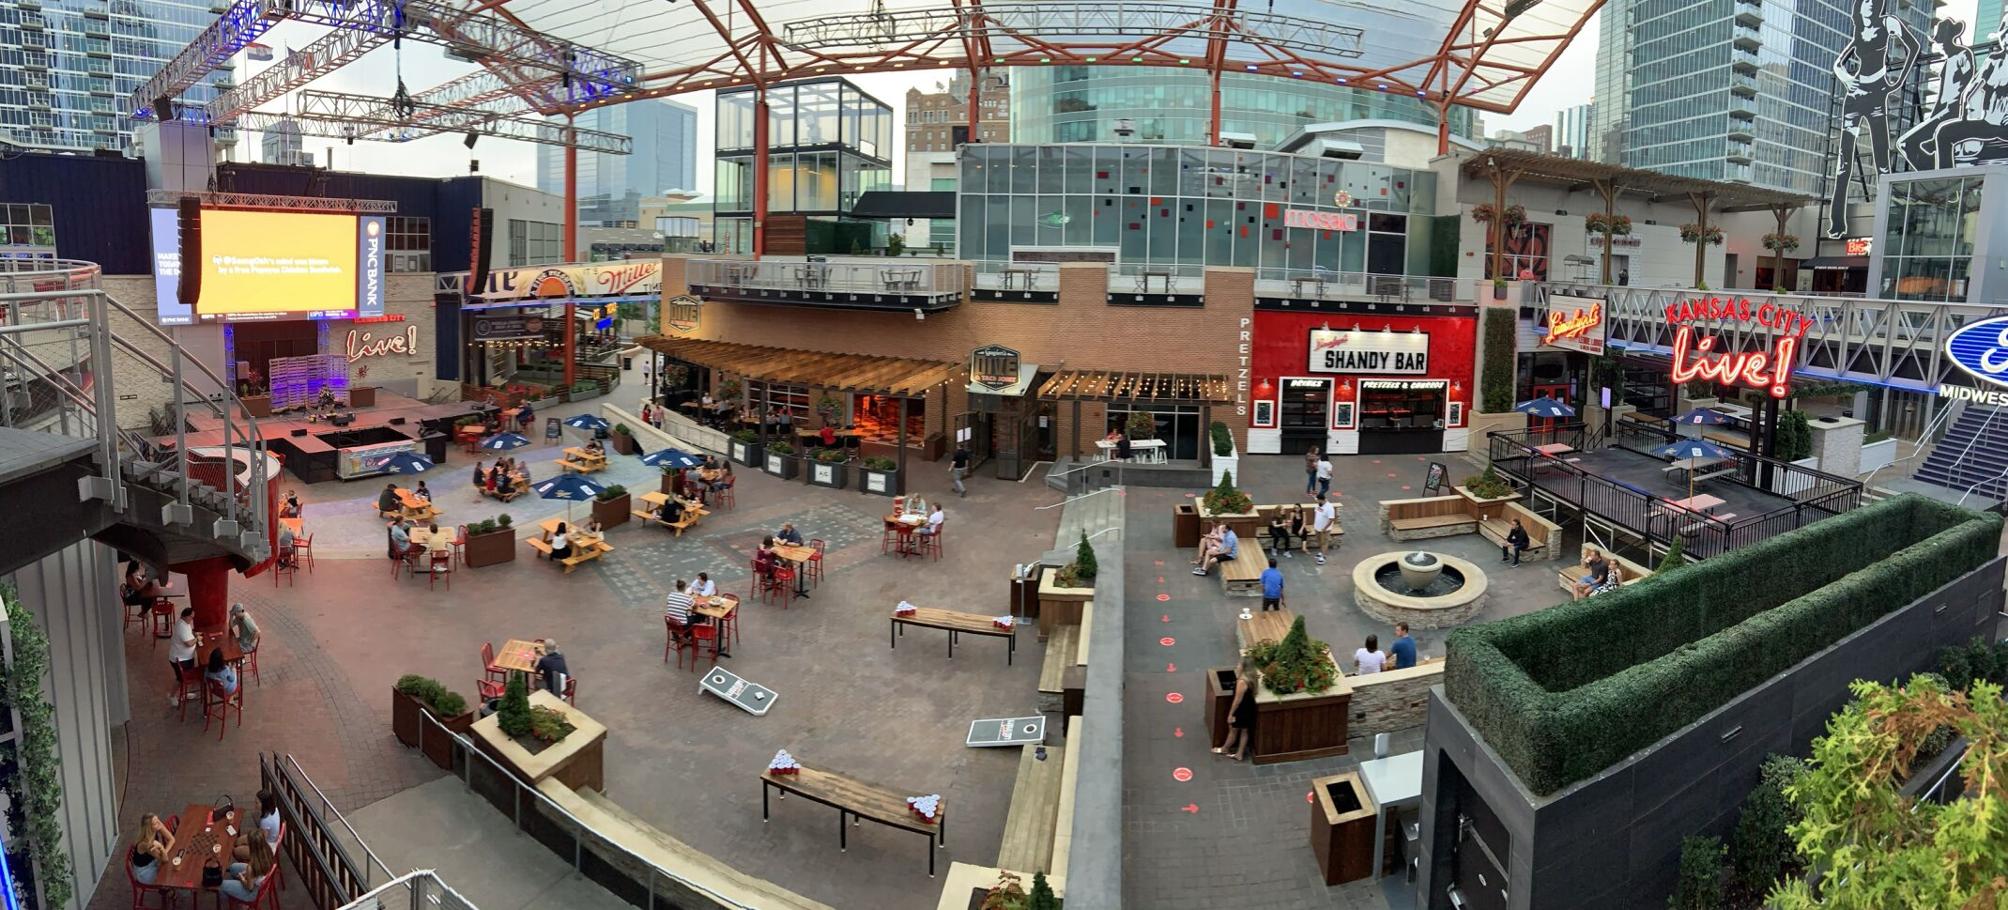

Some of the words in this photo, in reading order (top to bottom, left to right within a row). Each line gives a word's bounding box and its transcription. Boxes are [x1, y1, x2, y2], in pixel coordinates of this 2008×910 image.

[598, 263, 656, 294] Miller
[1666, 297, 1751, 325] KANSAS
[1757, 304, 1813, 337] CITY
[975, 357, 1018, 376] DIVE
[1236, 318, 1251, 416] PRETZELS
[1325, 350, 1390, 370] SHANDY
[1395, 352, 1425, 370] BAR
